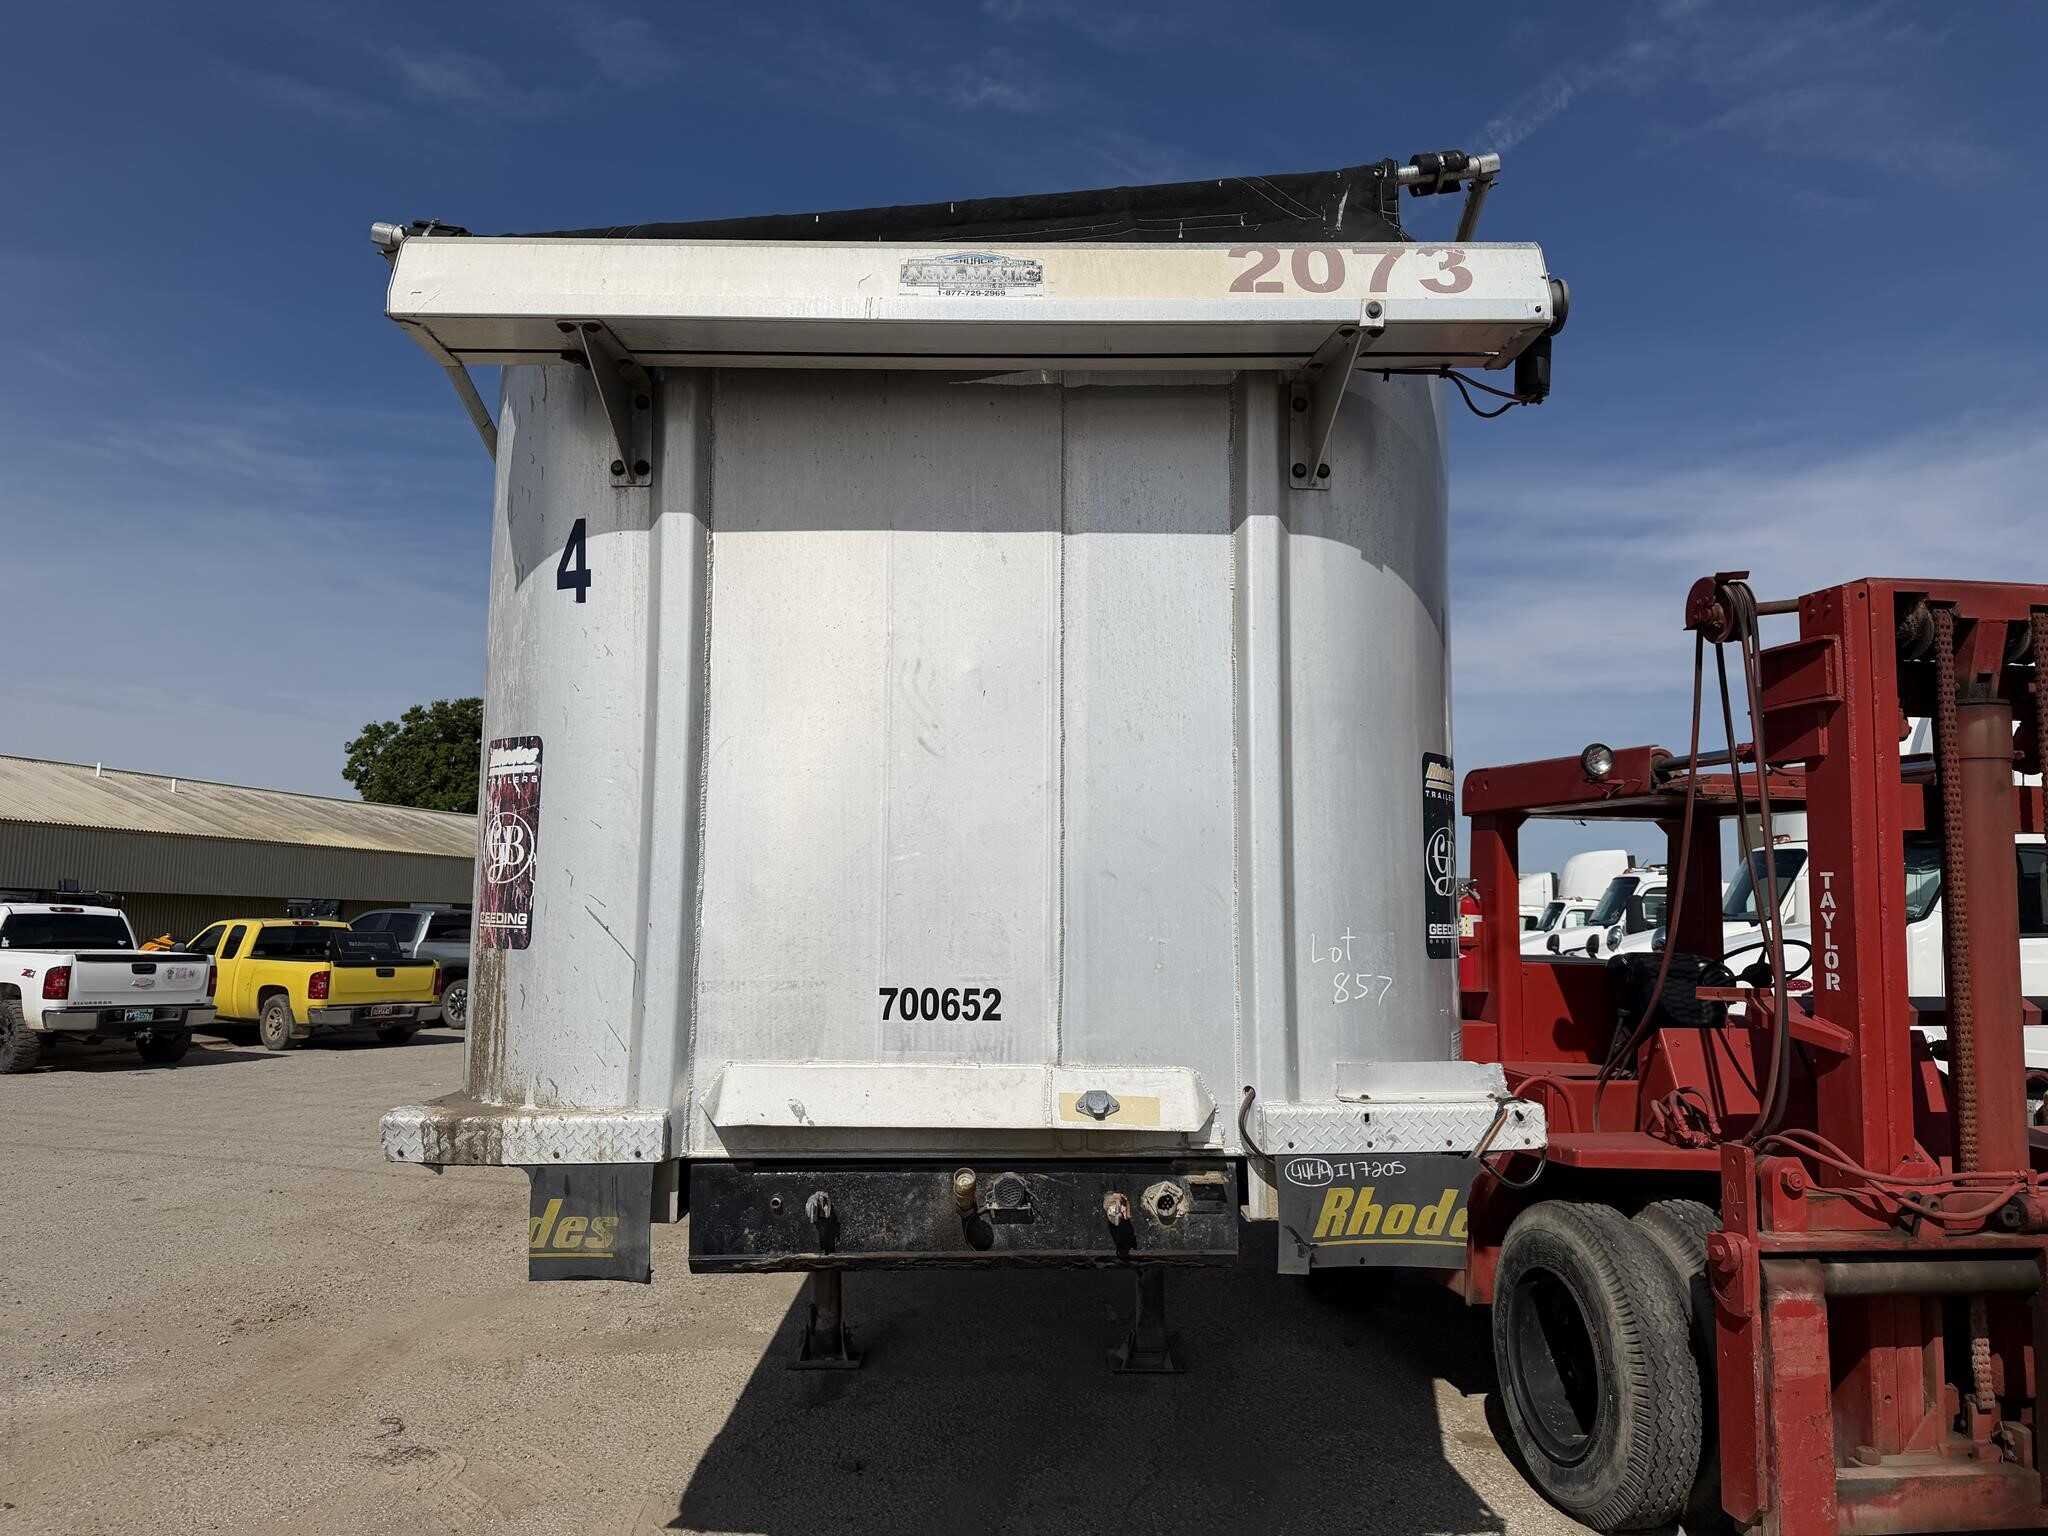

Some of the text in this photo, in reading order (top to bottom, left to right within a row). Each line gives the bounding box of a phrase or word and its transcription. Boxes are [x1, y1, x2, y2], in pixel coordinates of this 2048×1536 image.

[1228, 247, 1473, 294] 2073
[557, 518, 591, 604] 4
[1309, 926, 1361, 964] Lot
[1819, 871, 1841, 991] TAYLOR
[879, 987, 1002, 1021] 700652
[1333, 972, 1393, 1006] 857
